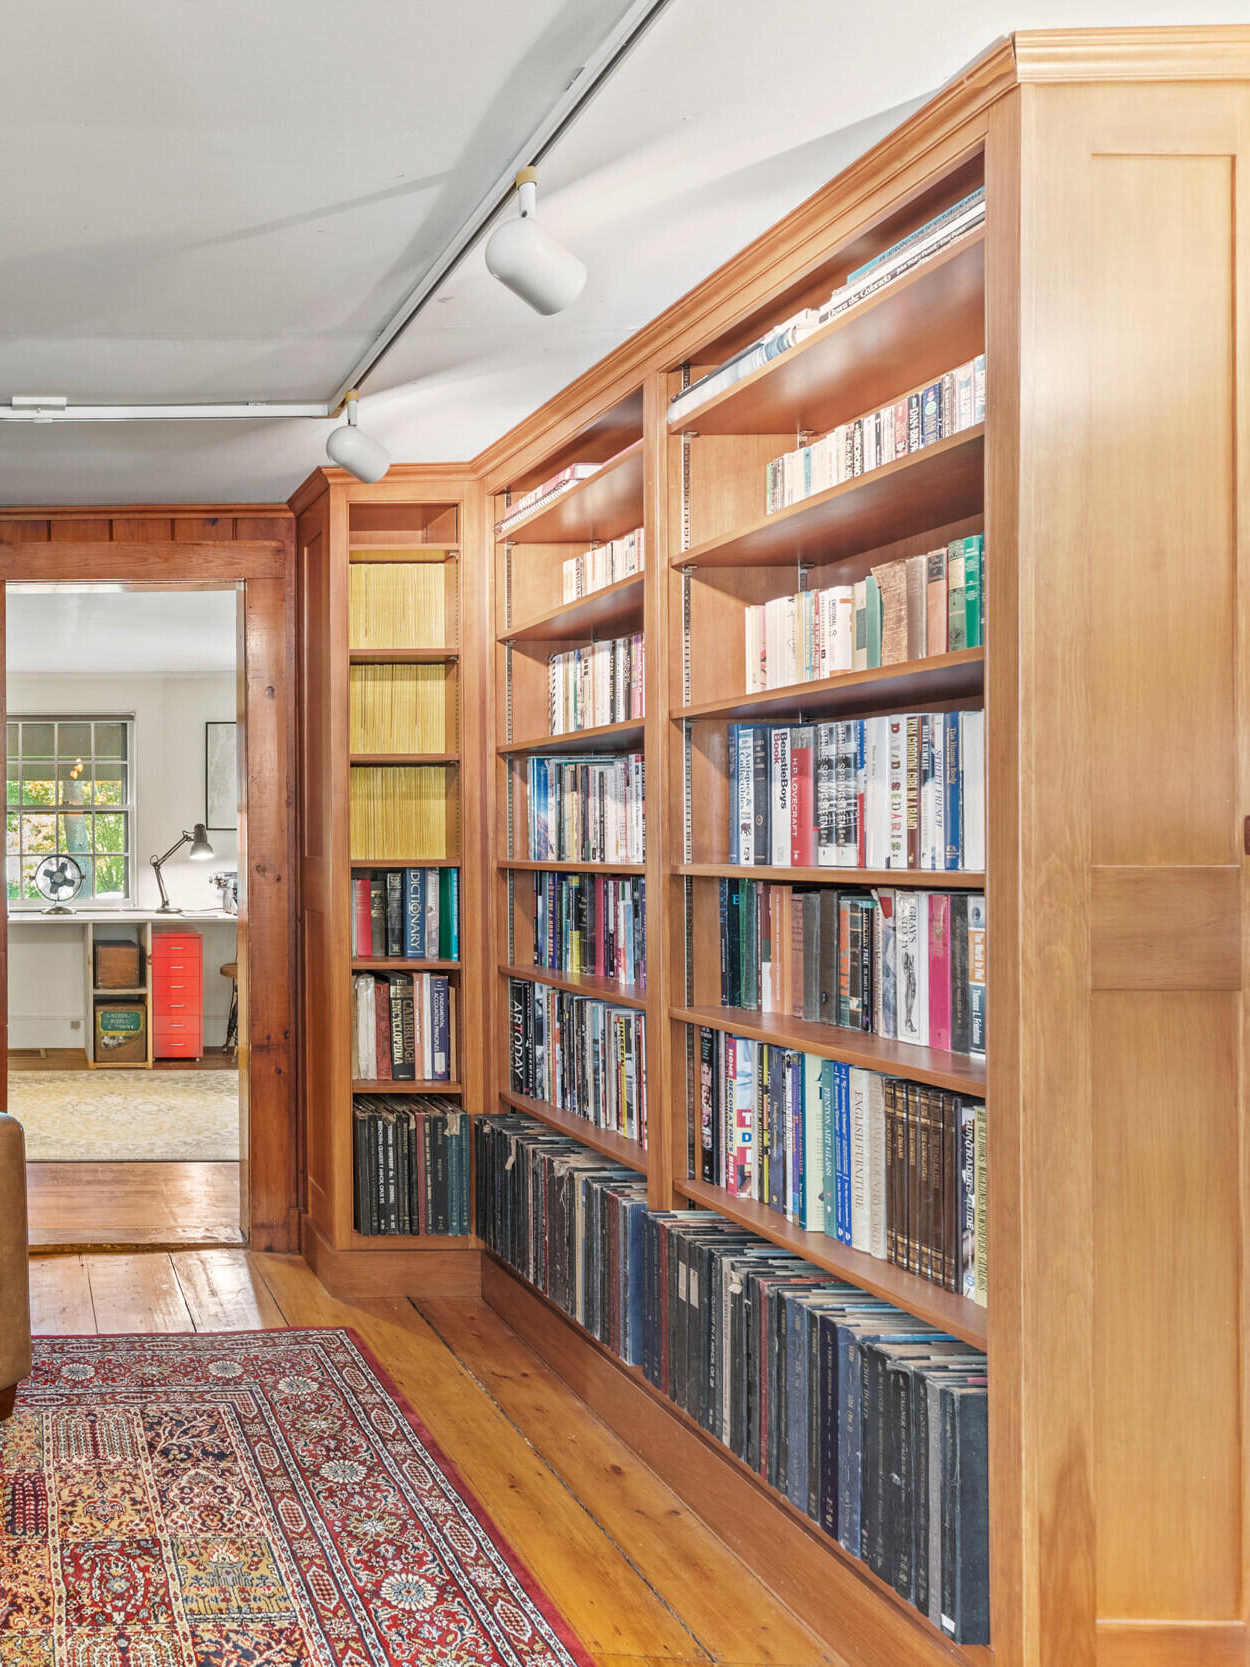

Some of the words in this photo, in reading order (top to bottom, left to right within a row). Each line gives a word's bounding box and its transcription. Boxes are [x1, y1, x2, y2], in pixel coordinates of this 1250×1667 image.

[910, 407, 919, 427] DAN
[907, 719, 918, 734] KIM
[891, 722, 901, 770] DAVID
[907, 736, 918, 770] GORDON
[780, 732, 789, 810] BeastieBoys
[907, 772, 918, 789] GIRL
[820, 764, 828, 828] SPRINGSTEEN
[837, 763, 846, 828] SPRINGSTEEN
[907, 791, 918, 800] IN
[891, 782, 901, 851] SEDARIS
[907, 808, 918, 830] BAND
[410, 872, 421, 950] DICTIONARY
[909, 906, 917, 944] GRAY'S
[974, 933, 984, 943] The
[974, 944, 984, 961] World
[974, 968, 984, 980] Flat
[972, 990, 982, 1011] Thomas
[392, 1000, 403, 1064] ENCYCLOPEDIA
[403, 1000, 414, 1064] CAMBRIDGE
[514, 1001, 523, 1079] ARTODAY
[972, 1018, 982, 1044] Friedman
[824, 1088, 832, 1123] FENTON
[854, 1091, 864, 1140] ENGLISH
[824, 1128, 832, 1144] ART
[966, 1119, 974, 1139] GUN
[978, 1126, 986, 1141] OLD
[824, 1148, 832, 1176] GLASS
[966, 1142, 974, 1192] TRADER'S
[978, 1142, 986, 1161] BOOKS
[854, 1142, 864, 1210] FURNITURE
[978, 1166, 986, 1205] MAGAZINES
[966, 1197, 974, 1230] GUIDE
[978, 1209, 986, 1253] NEWSPAPERS
[978, 1258, 986, 1291] CATALOGS
[710, 1325, 715, 1334] IN
